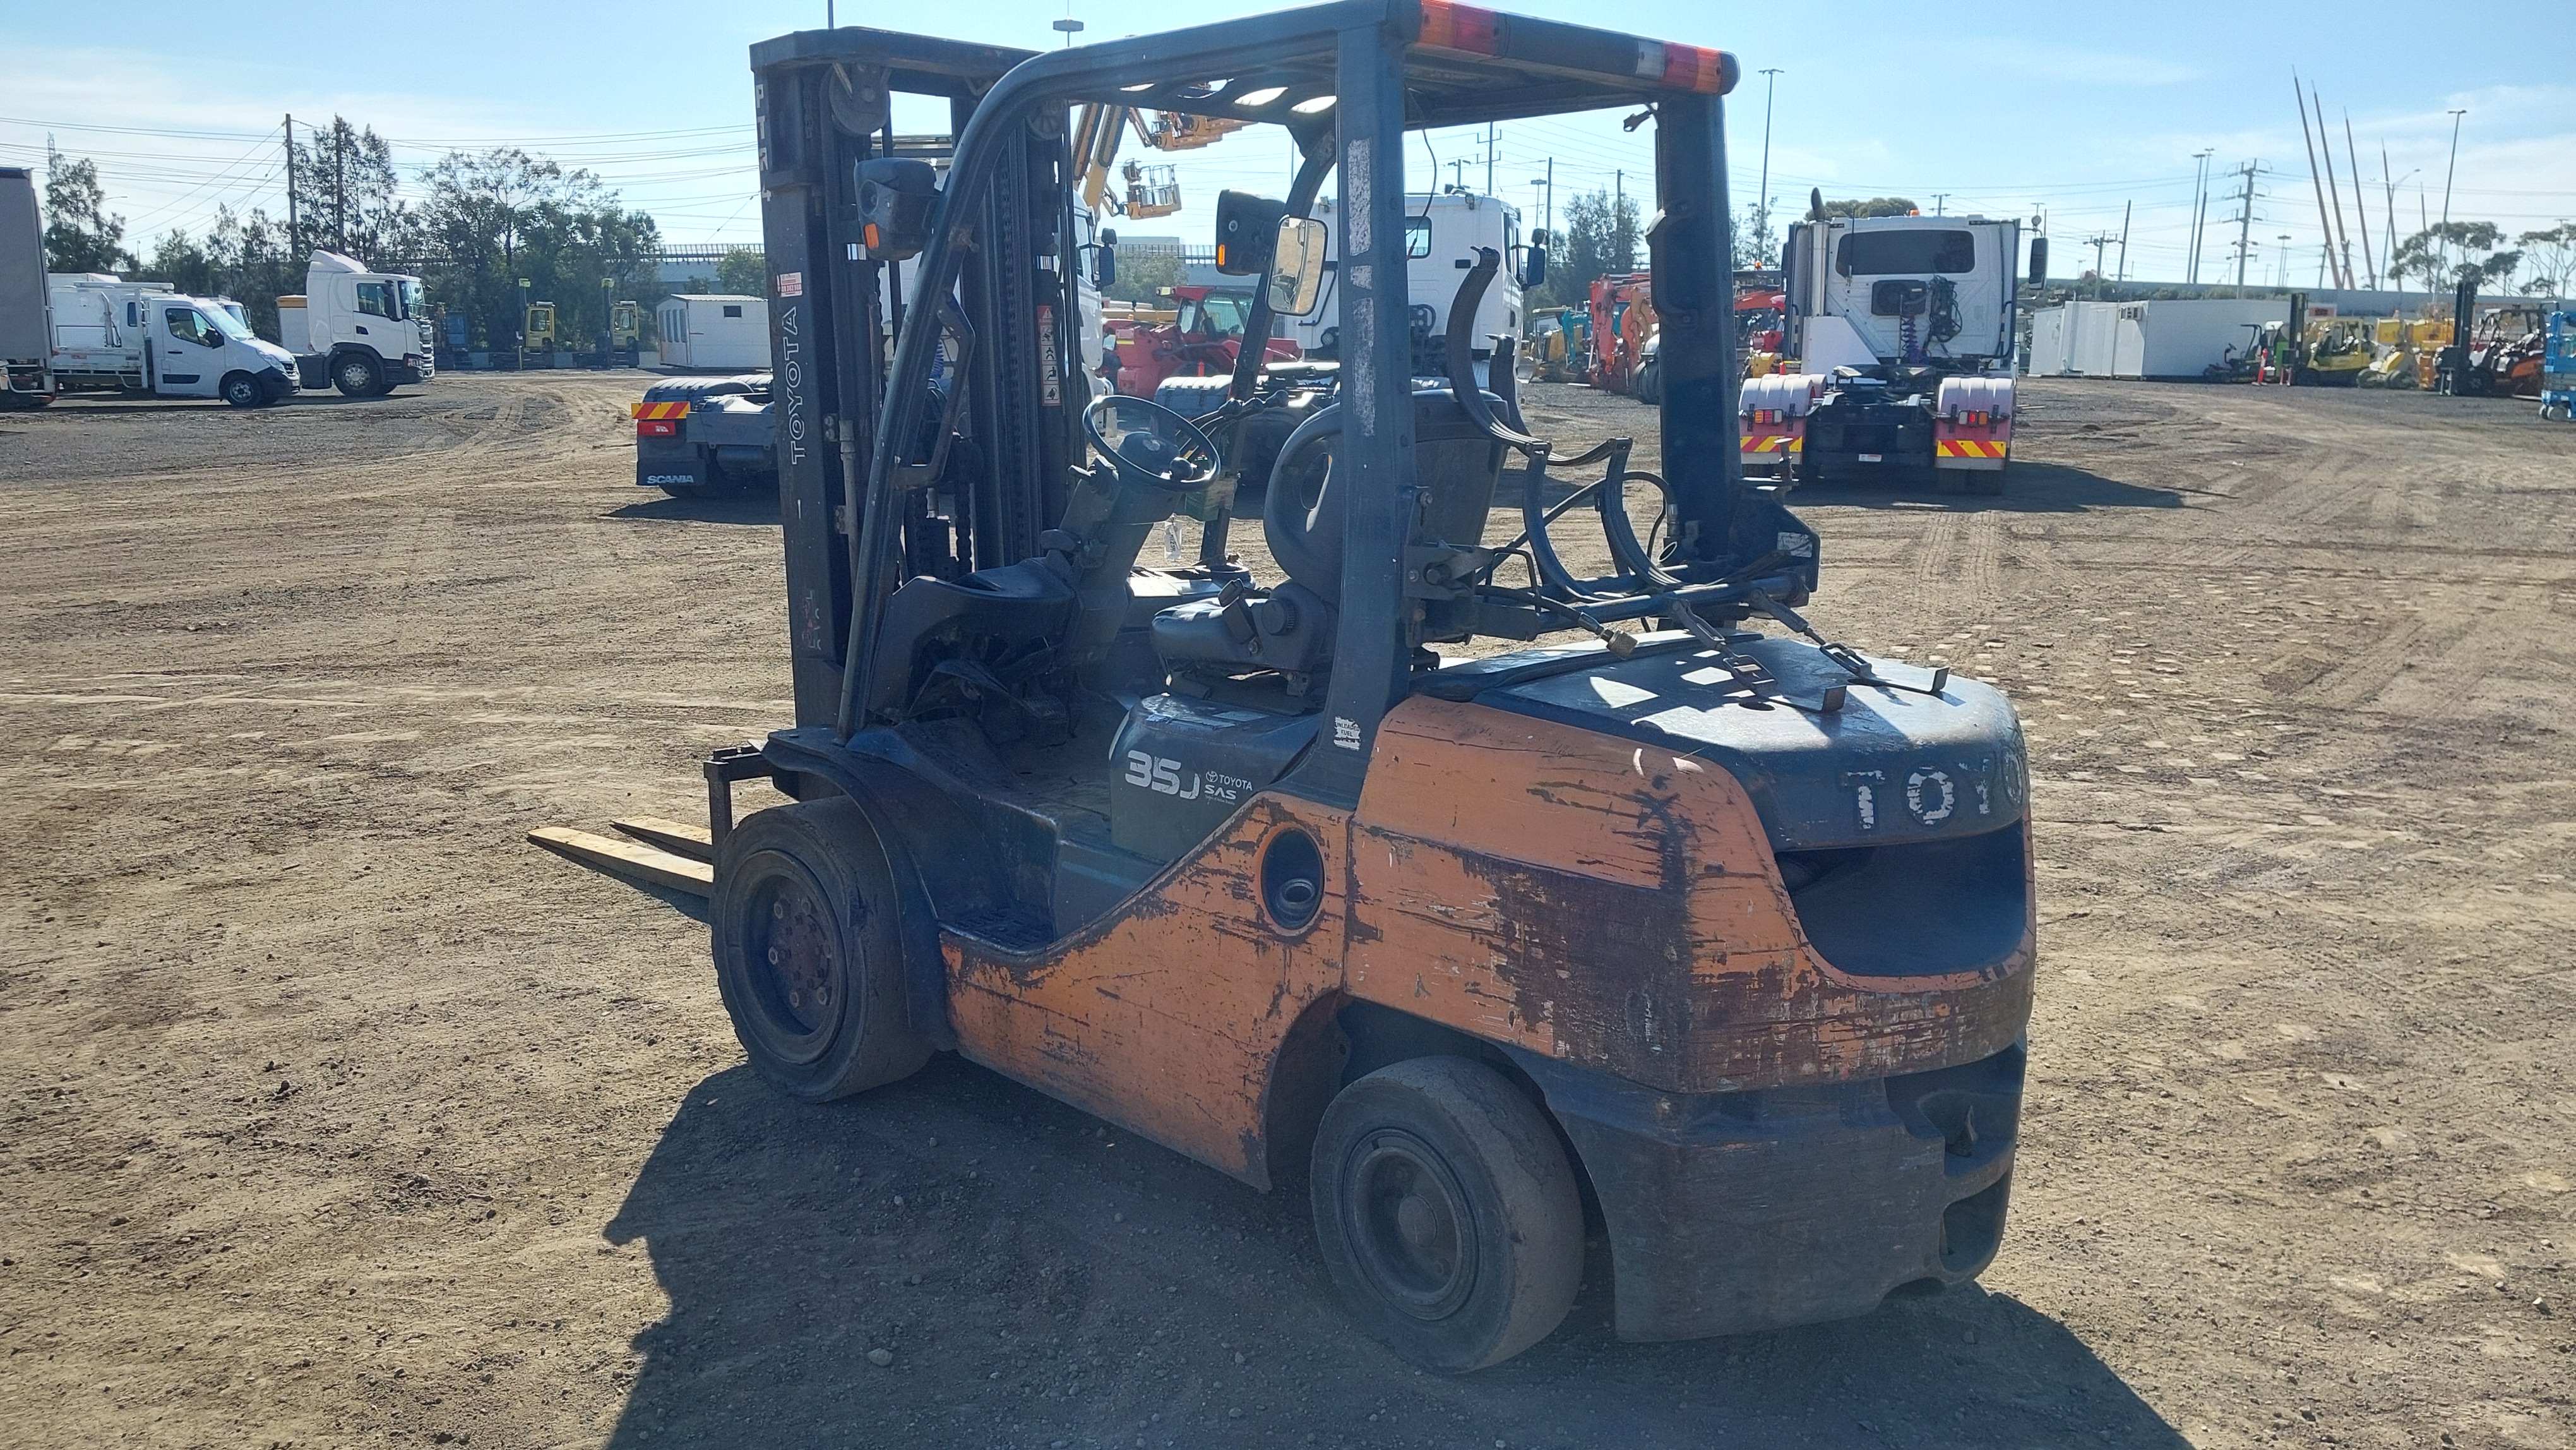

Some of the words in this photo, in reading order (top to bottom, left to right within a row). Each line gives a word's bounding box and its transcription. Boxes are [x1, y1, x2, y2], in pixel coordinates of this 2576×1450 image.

[782, 306, 806, 465] TOYOTA
[647, 475, 694, 484] SCANIA
[1125, 750, 1200, 800] 35J
[1219, 774, 1253, 791] TOYOTA
[1205, 784, 1237, 800] SAS
